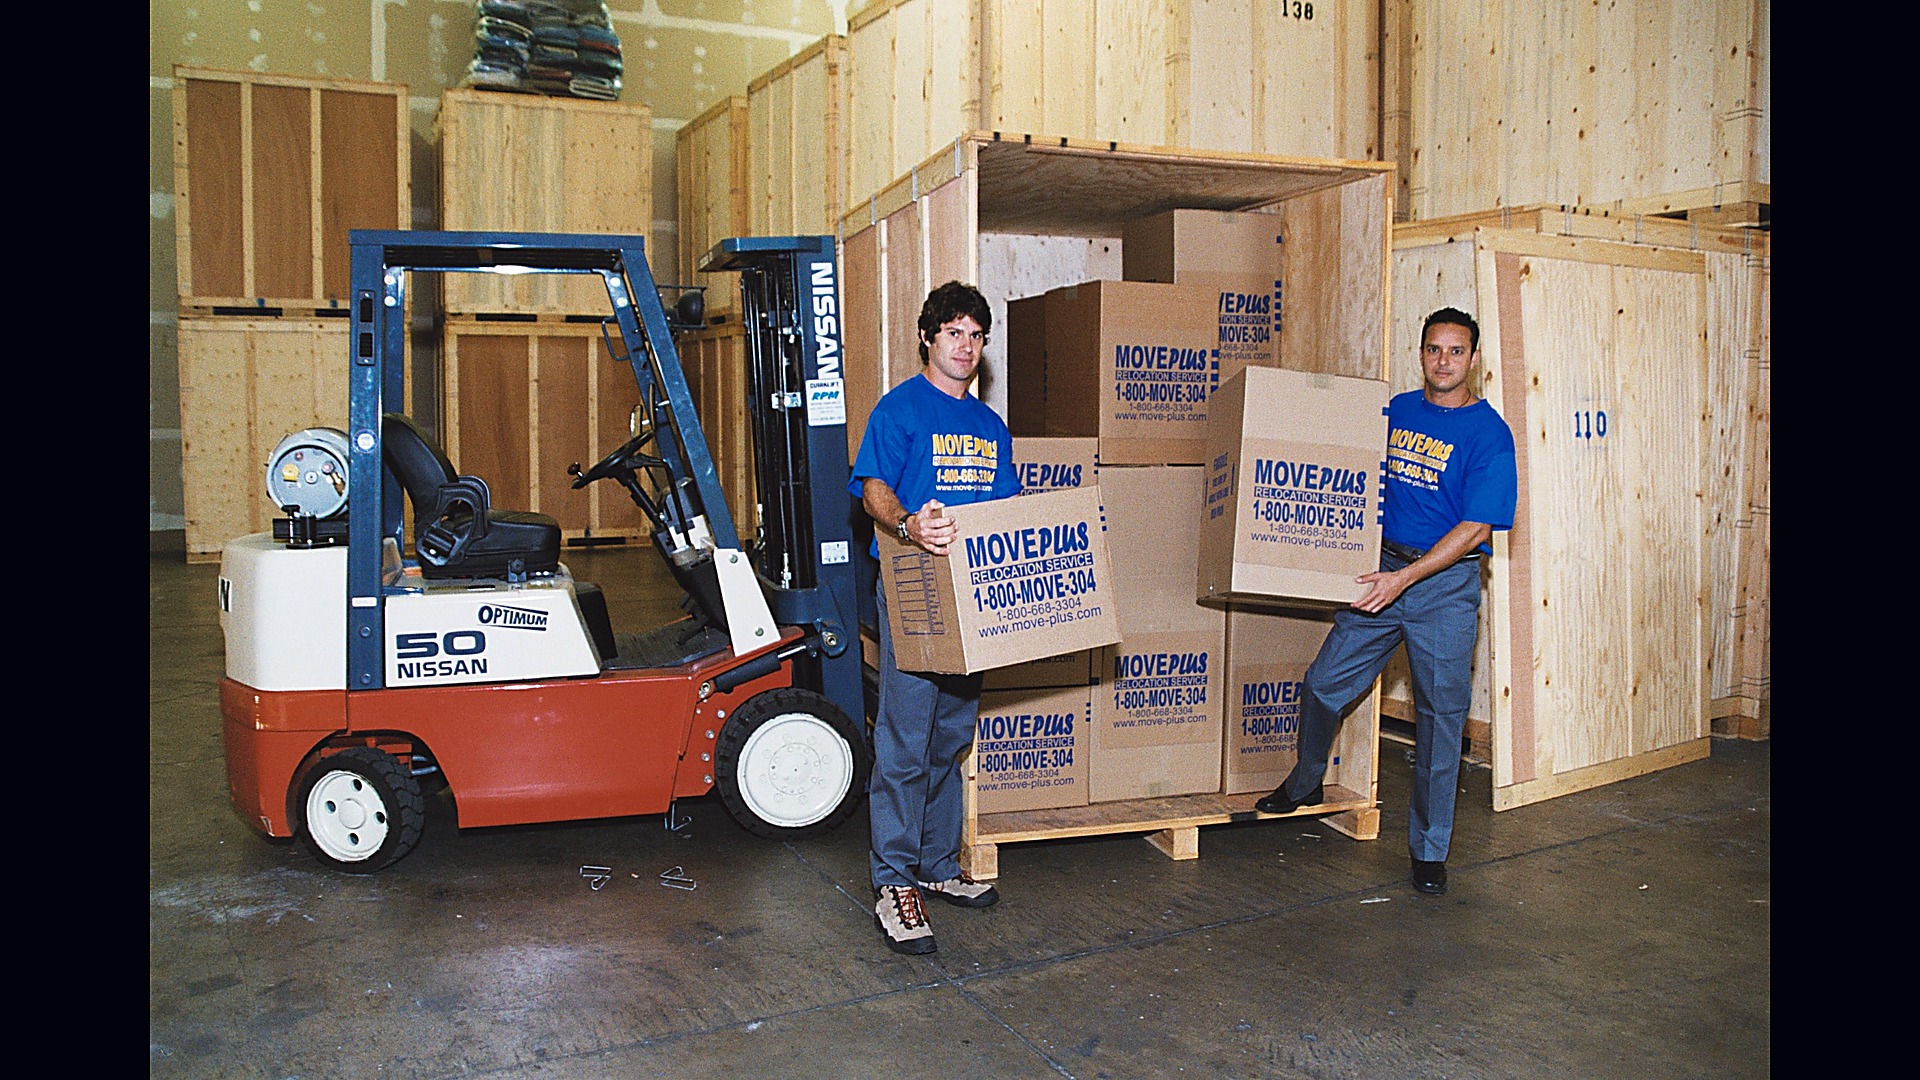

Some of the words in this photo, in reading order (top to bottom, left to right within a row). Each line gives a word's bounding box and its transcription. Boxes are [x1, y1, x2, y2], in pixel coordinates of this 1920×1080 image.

[1283, 0, 1314, 20] 138
[811, 262, 839, 379] NISSAN
[1219, 326, 1271, 343] MOVE-304
[1116, 371, 1170, 381] RELOCATION
[1171, 372, 1207, 382] SERVICE
[811, 391, 840, 401] RPM
[1115, 383, 1207, 403] 1-800-MOVE-304
[1115, 412, 1207, 423] www.move-plus.com
[1129, 403, 1194, 412] 1-800-668-3304
[1574, 411, 1607, 440] 110
[1012, 463, 1083, 487] VEPLUS
[1254, 487, 1319, 503] RELOCATION
[1321, 494, 1365, 508] SERVICE
[1253, 500, 1364, 531] 1-800-MOVE-304
[1268, 523, 1348, 540] 1-800-668-3304
[1250, 532, 1364, 552] www.move-plus.com
[972, 562, 1044, 585] RELOCATION
[1045, 553, 1092, 571] SERVICE
[973, 568, 1096, 613] 1-800-MOVE-304
[478, 605, 548, 626] OPTIMUM
[997, 597, 1082, 622] 1-800-668-3304
[978, 605, 1102, 638] www.move-plus.com
[396, 630, 486, 659] 50
[397, 658, 488, 679] NISSAN
[1115, 678, 1170, 690] RELOCATION
[1170, 675, 1207, 687] SERVICE
[1114, 686, 1206, 710] 1-800-MOVE-304
[1243, 681, 1303, 705] MOVEP
[1128, 707, 1193, 718] 1-800-668-3304
[1243, 705, 1294, 716] RELOCATION
[1113, 714, 1207, 728] www.move-plus.com
[1242, 716, 1299, 736] 1-800-MOV
[977, 741, 1034, 752] RELOCATION
[1035, 737, 1074, 747] SERVICE
[1241, 744, 1296, 754] www.move-p
[1255, 735, 1296, 744] 1-800-668-
[977, 748, 1074, 773] 1-800-MOVE-304
[990, 769, 1060, 781] 1-800-668-3304
